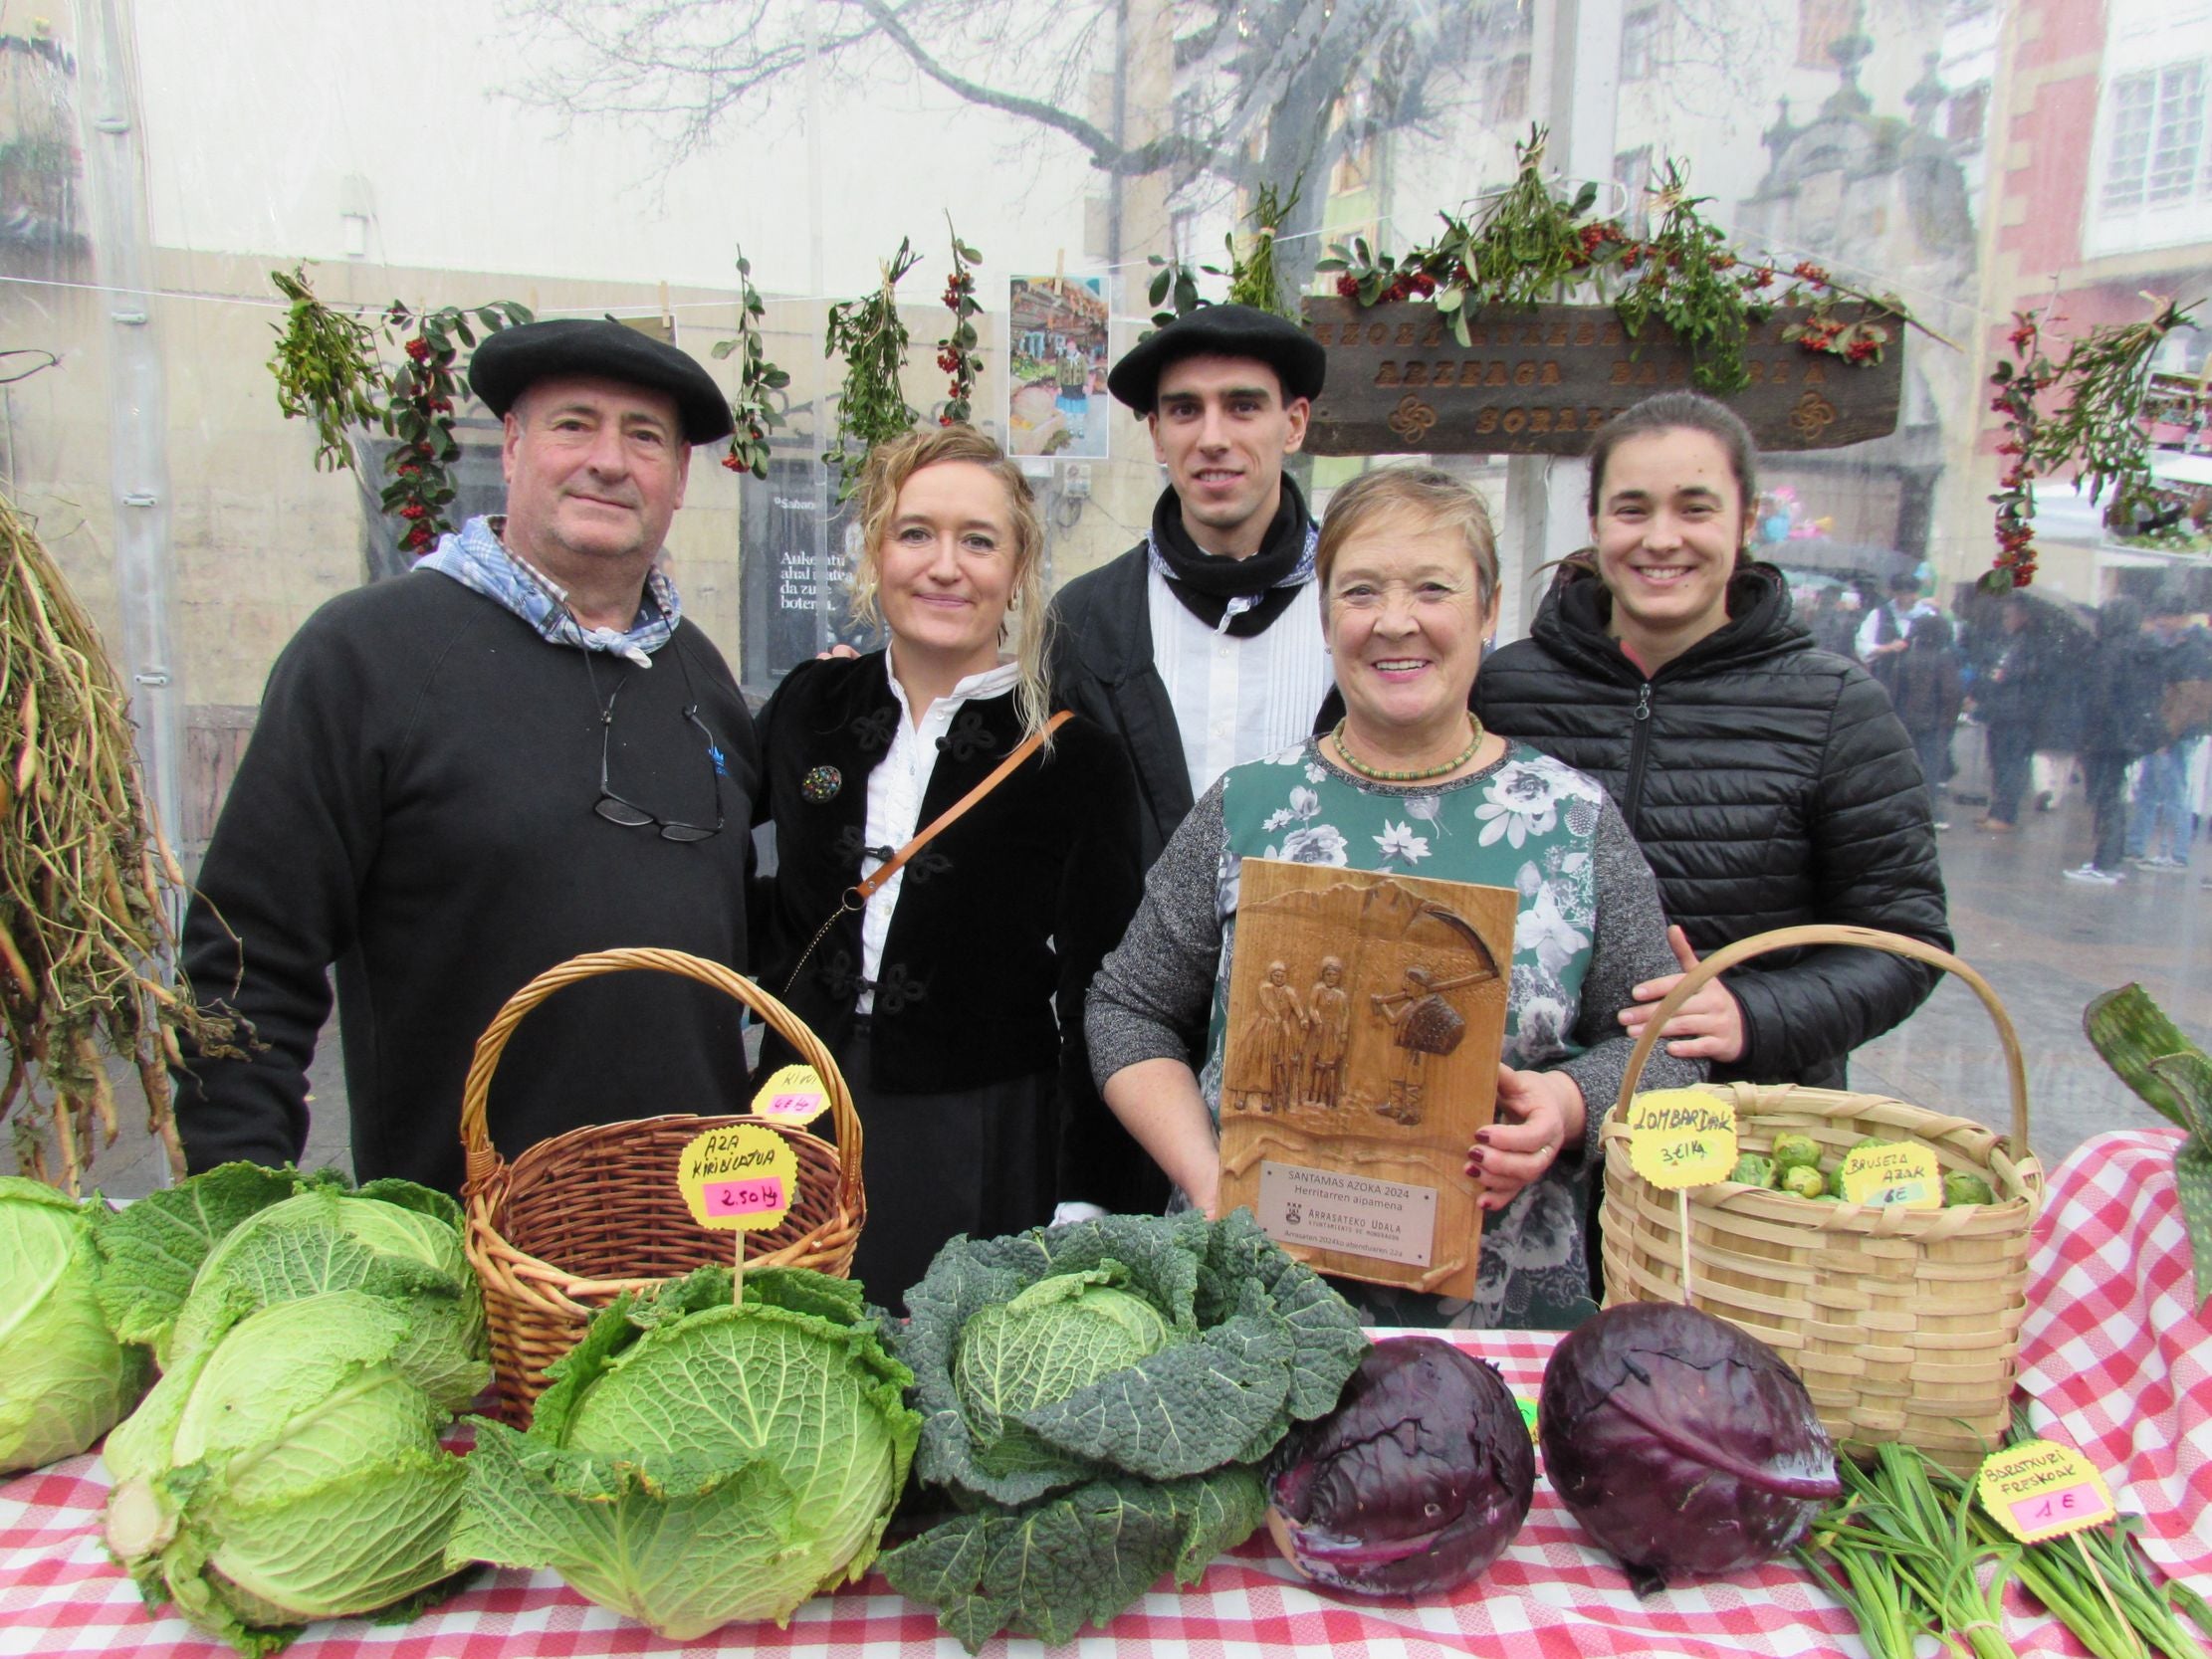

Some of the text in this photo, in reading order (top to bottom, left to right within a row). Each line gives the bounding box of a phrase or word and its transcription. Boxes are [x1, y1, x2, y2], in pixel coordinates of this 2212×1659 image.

[1612, 360, 1825, 385] BASRIA
[780, 566, 809, 580] ahal
[780, 580, 797, 594] da
[1288, 1170, 1410, 1199] SANTAMAS AZOKA 2024
[1294, 1184, 1403, 1211] Herritarren aipamena
[1308, 1208, 1401, 1234] ARRASATEKO UDALA
[2001, 1464, 2078, 1494] FRESKOAK
